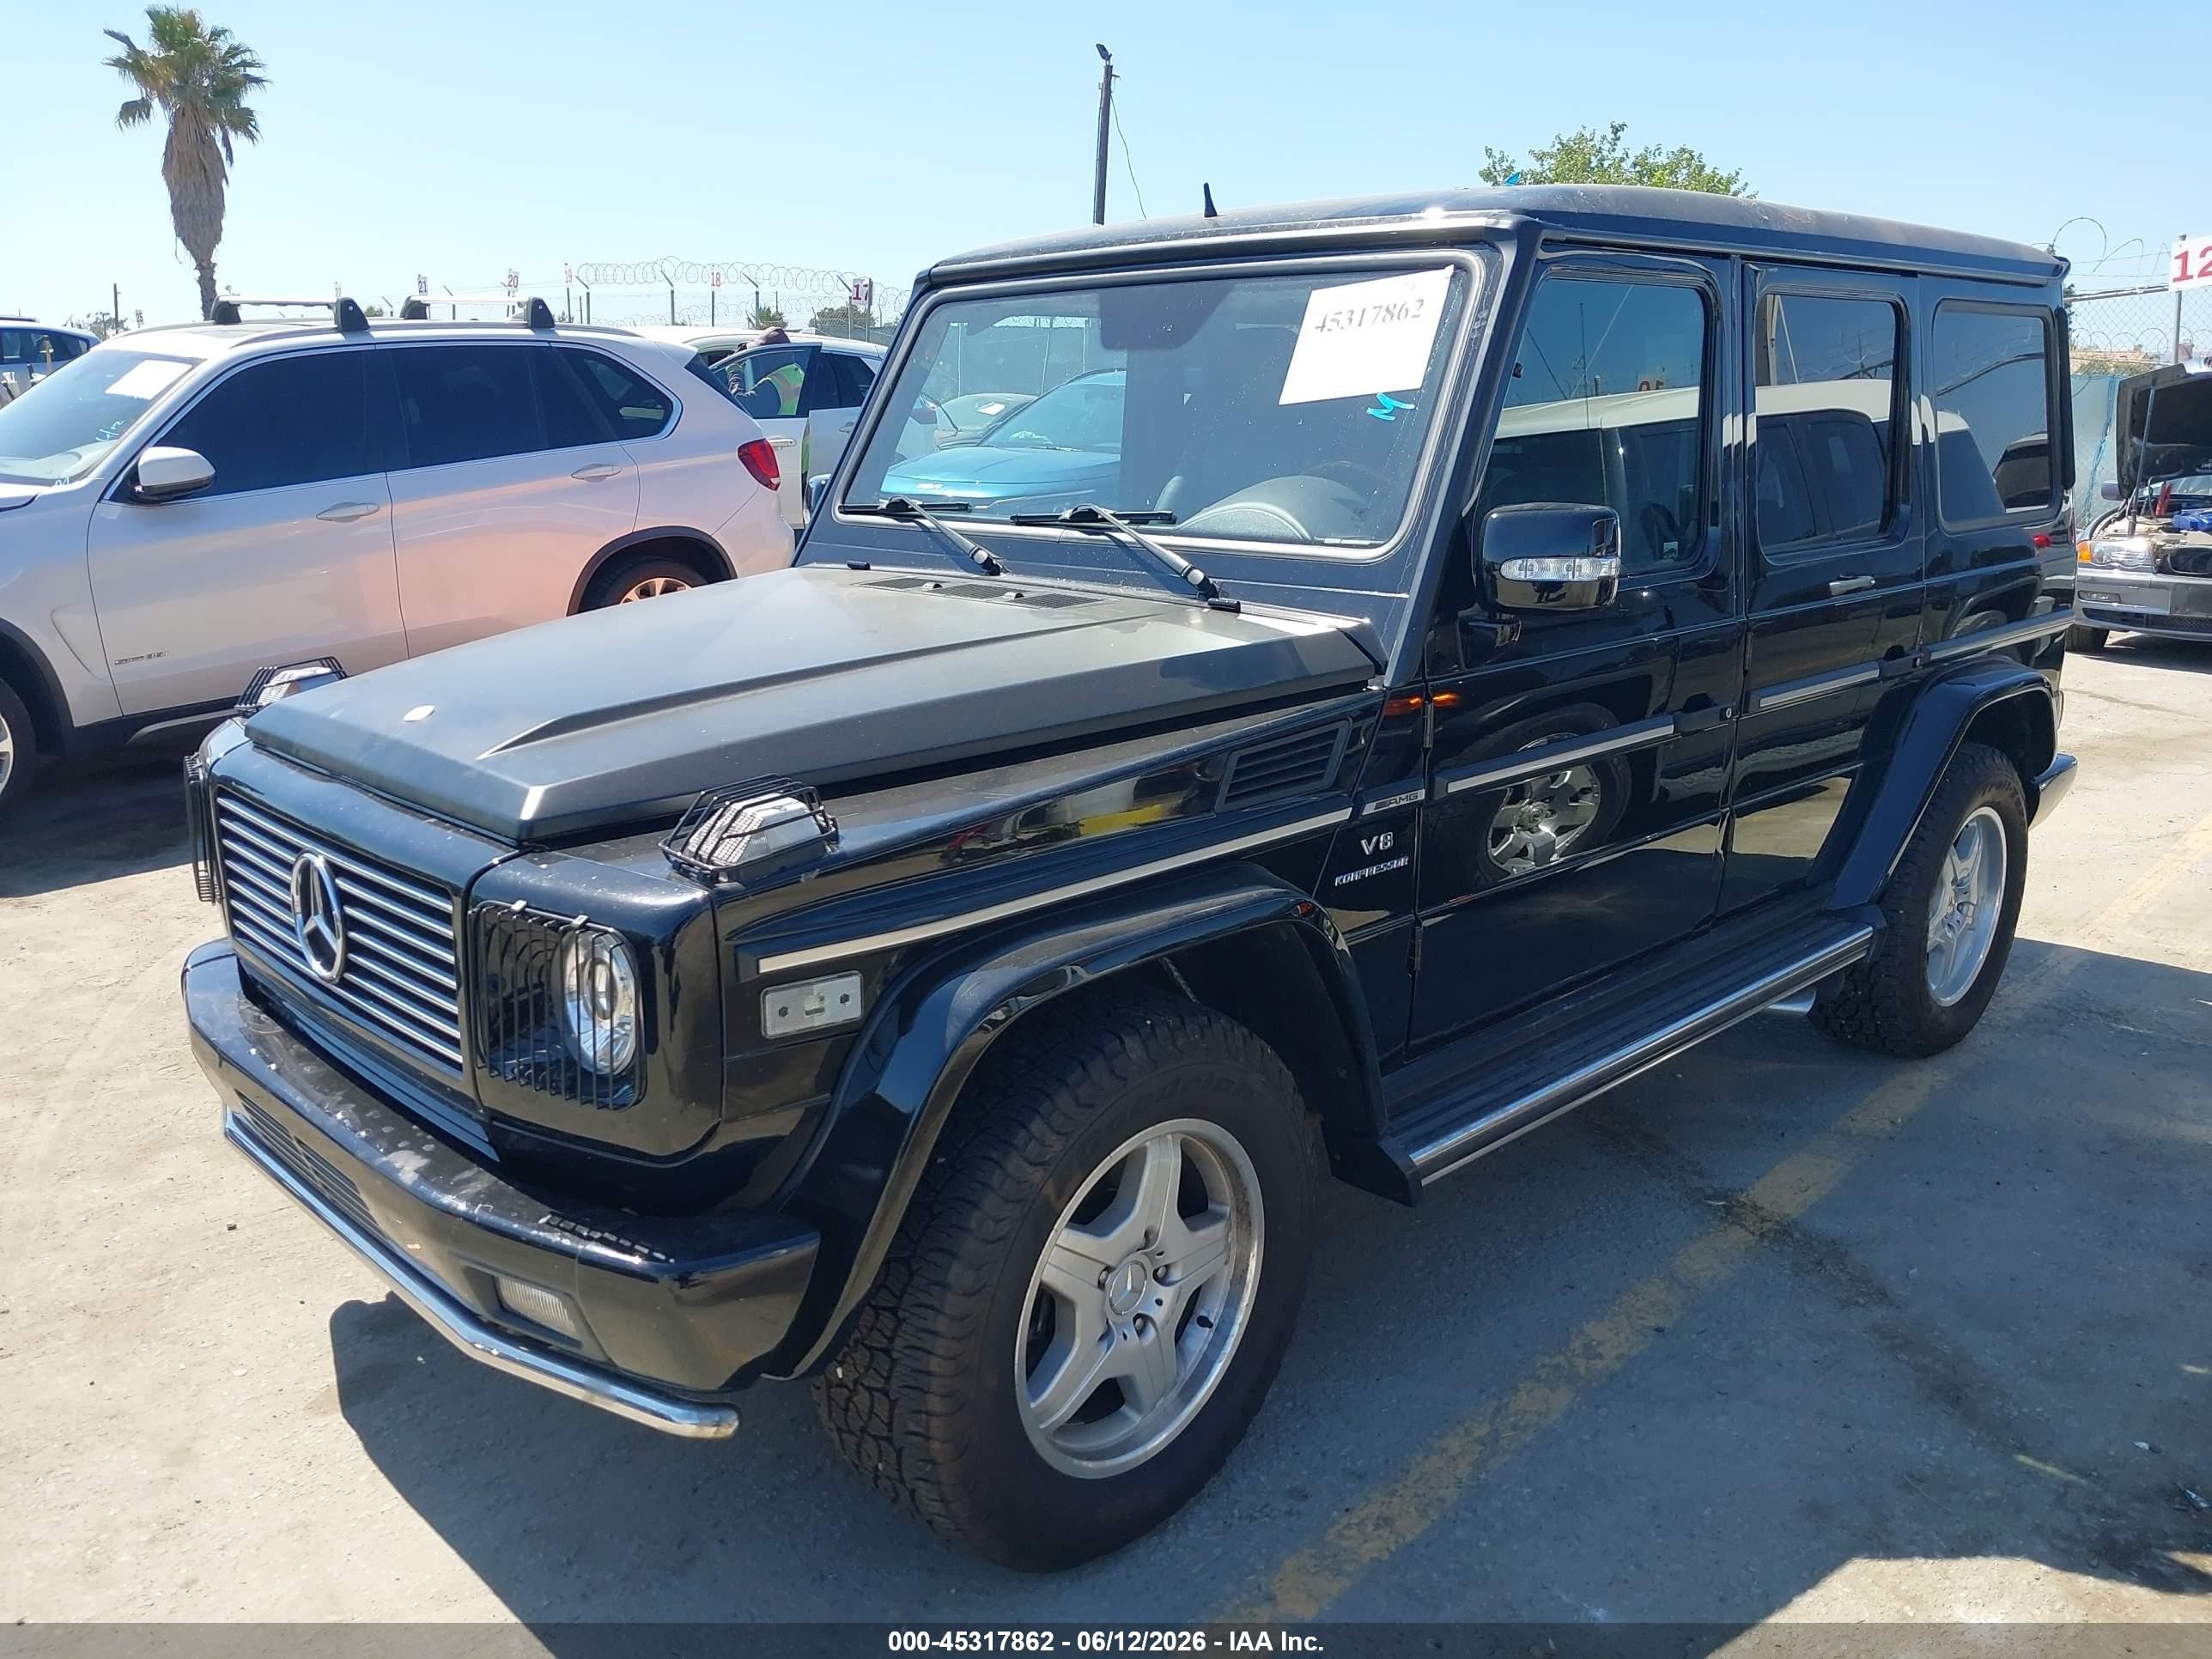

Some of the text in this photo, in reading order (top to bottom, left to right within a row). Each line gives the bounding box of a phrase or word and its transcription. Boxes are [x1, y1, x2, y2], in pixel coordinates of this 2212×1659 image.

[507, 274, 519, 289] 20
[565, 269, 573, 283] 19
[711, 271, 721, 288] 18
[418, 281, 428, 293] 21
[853, 283, 869, 301] 17
[1314, 298, 1425, 334] 45317862
[1386, 792, 1419, 807] AMG
[1359, 831, 1394, 855] V8
[1334, 856, 1410, 887] KOMPRESSOR
